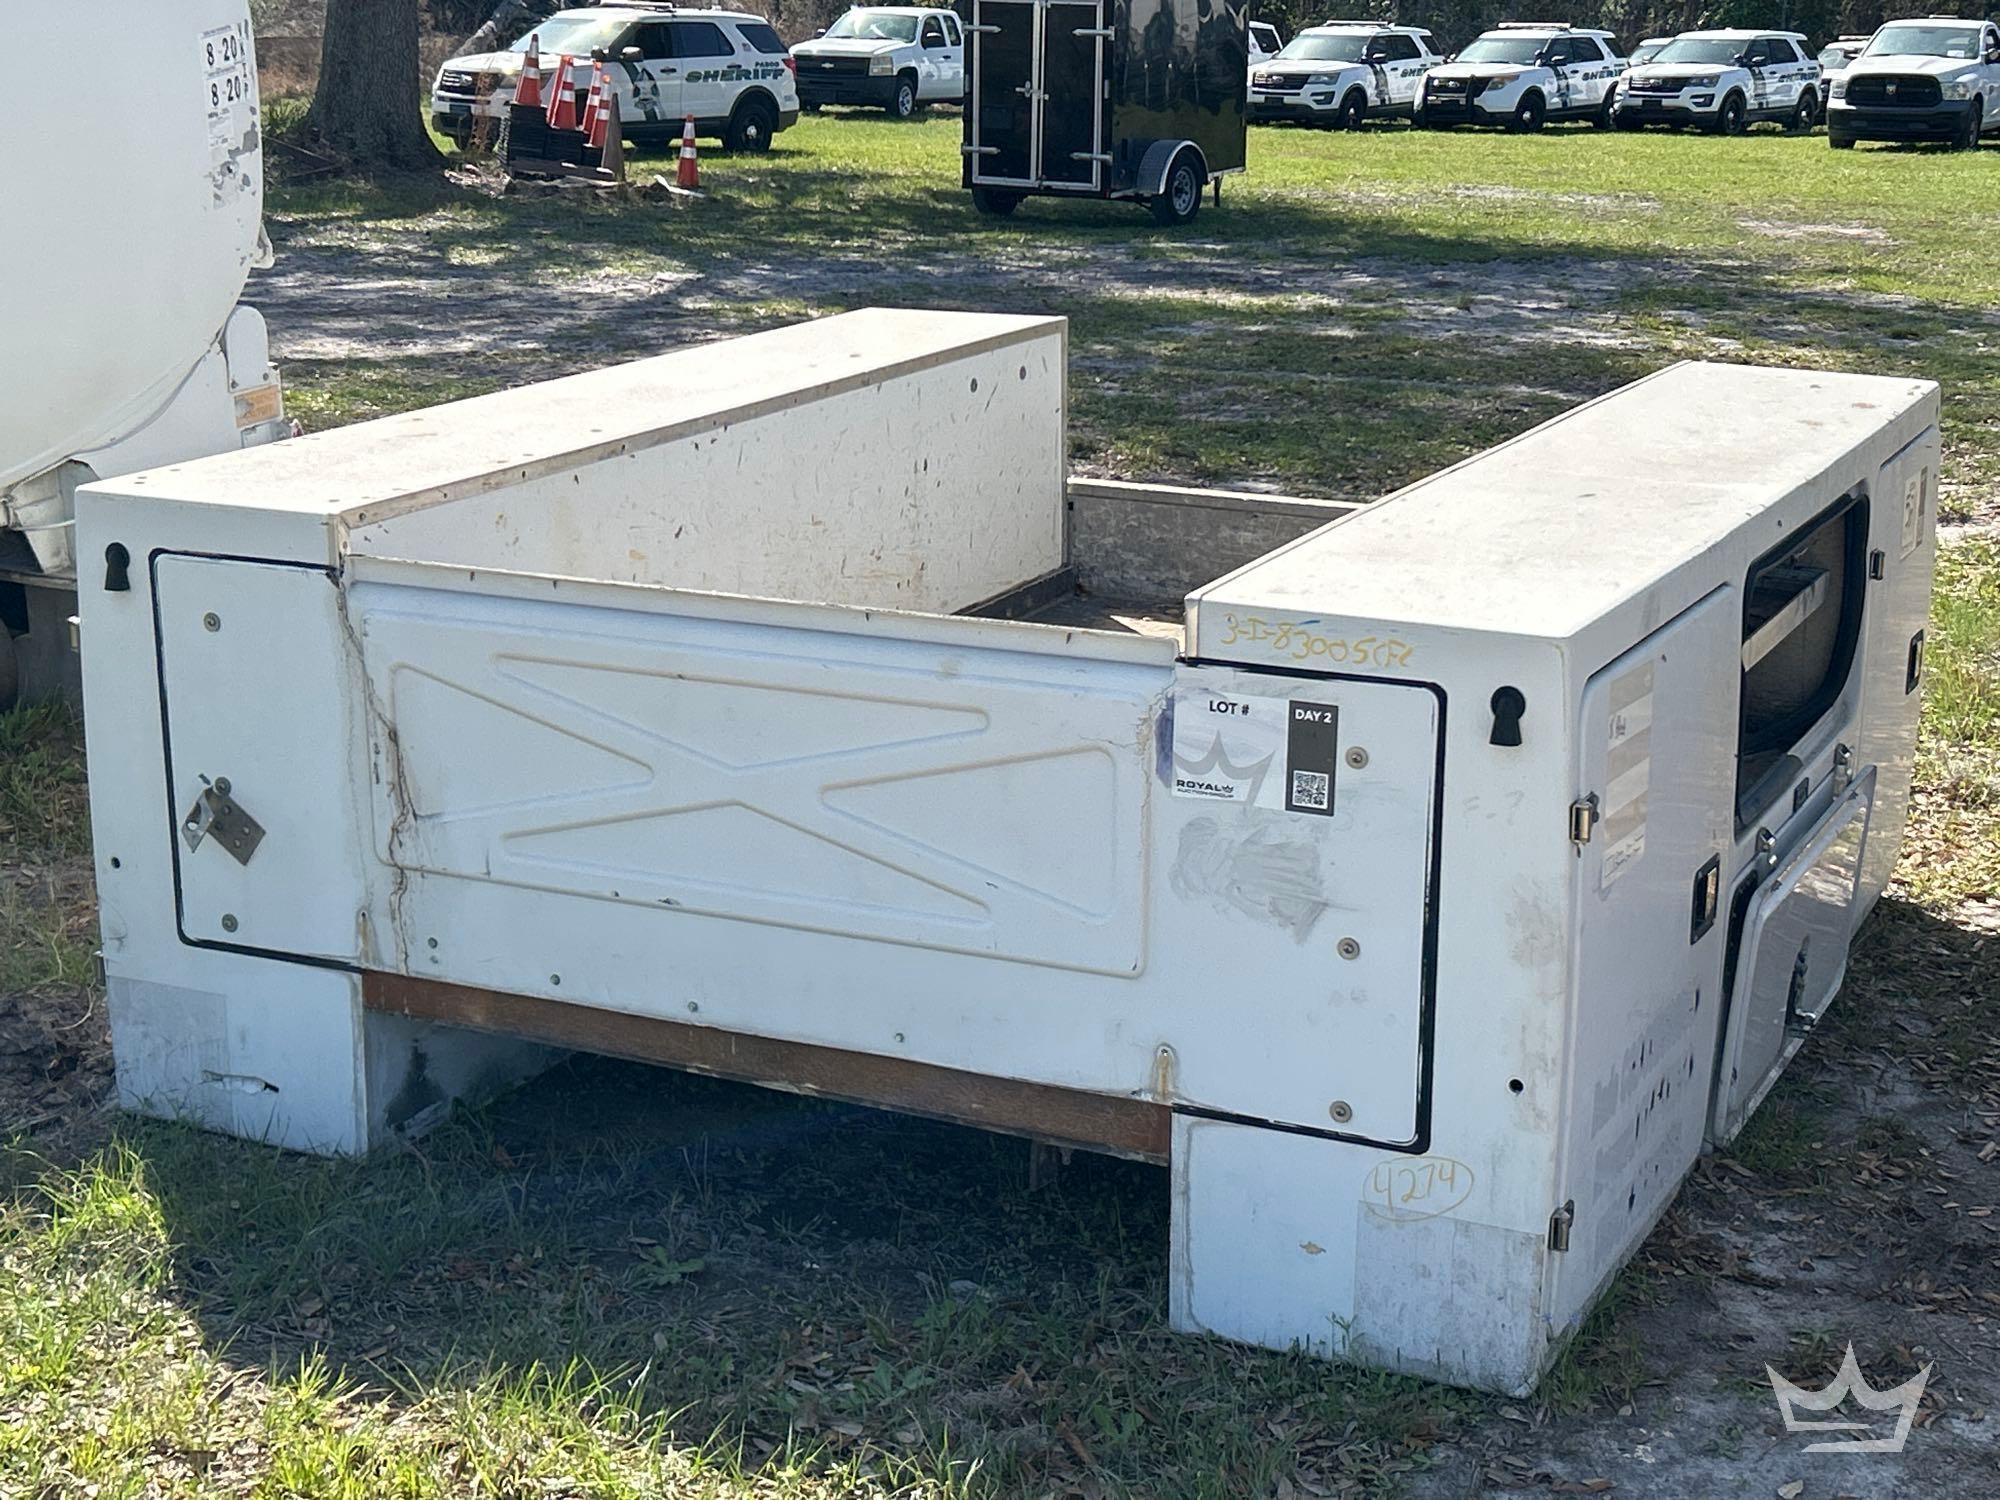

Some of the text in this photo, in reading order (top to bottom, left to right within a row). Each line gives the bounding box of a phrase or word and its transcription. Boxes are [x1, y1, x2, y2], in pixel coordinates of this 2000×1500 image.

[685, 68, 785, 83] SHERIFF
[1209, 700, 1251, 716] LOT #
[1295, 708, 1333, 724] DAY 2
[1176, 779, 1222, 792] ROYAL
[1373, 1160, 1456, 1214] 4274
